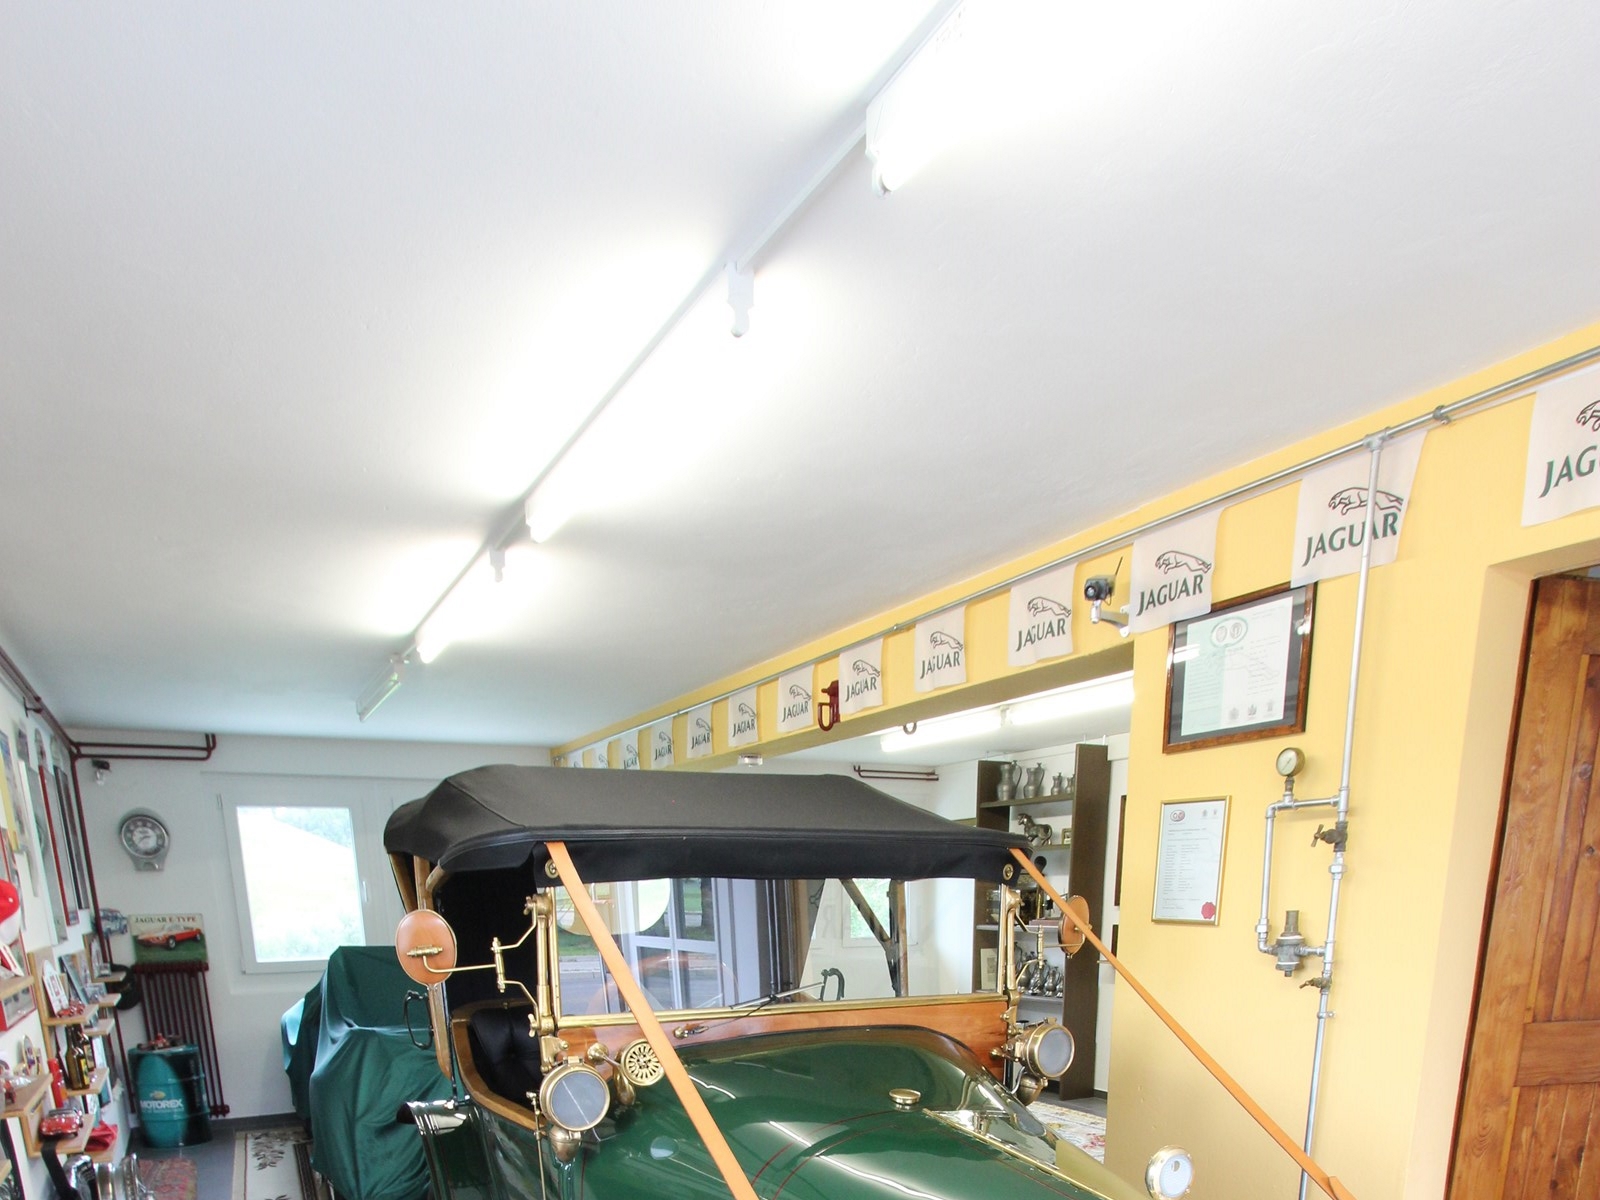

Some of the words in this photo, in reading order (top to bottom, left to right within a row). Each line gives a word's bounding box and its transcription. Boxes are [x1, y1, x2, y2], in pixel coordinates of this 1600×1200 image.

[1538, 445, 1600, 498] JAG
[1136, 574, 1204, 616] JAGUAR
[1016, 618, 1066, 652] JAGUAR
[845, 676, 877, 702] JAGUAR
[782, 701, 809, 722] JAGUAR
[135, 916, 167, 924] JAGUAR
[140, 1099, 184, 1109] MOTOREX
